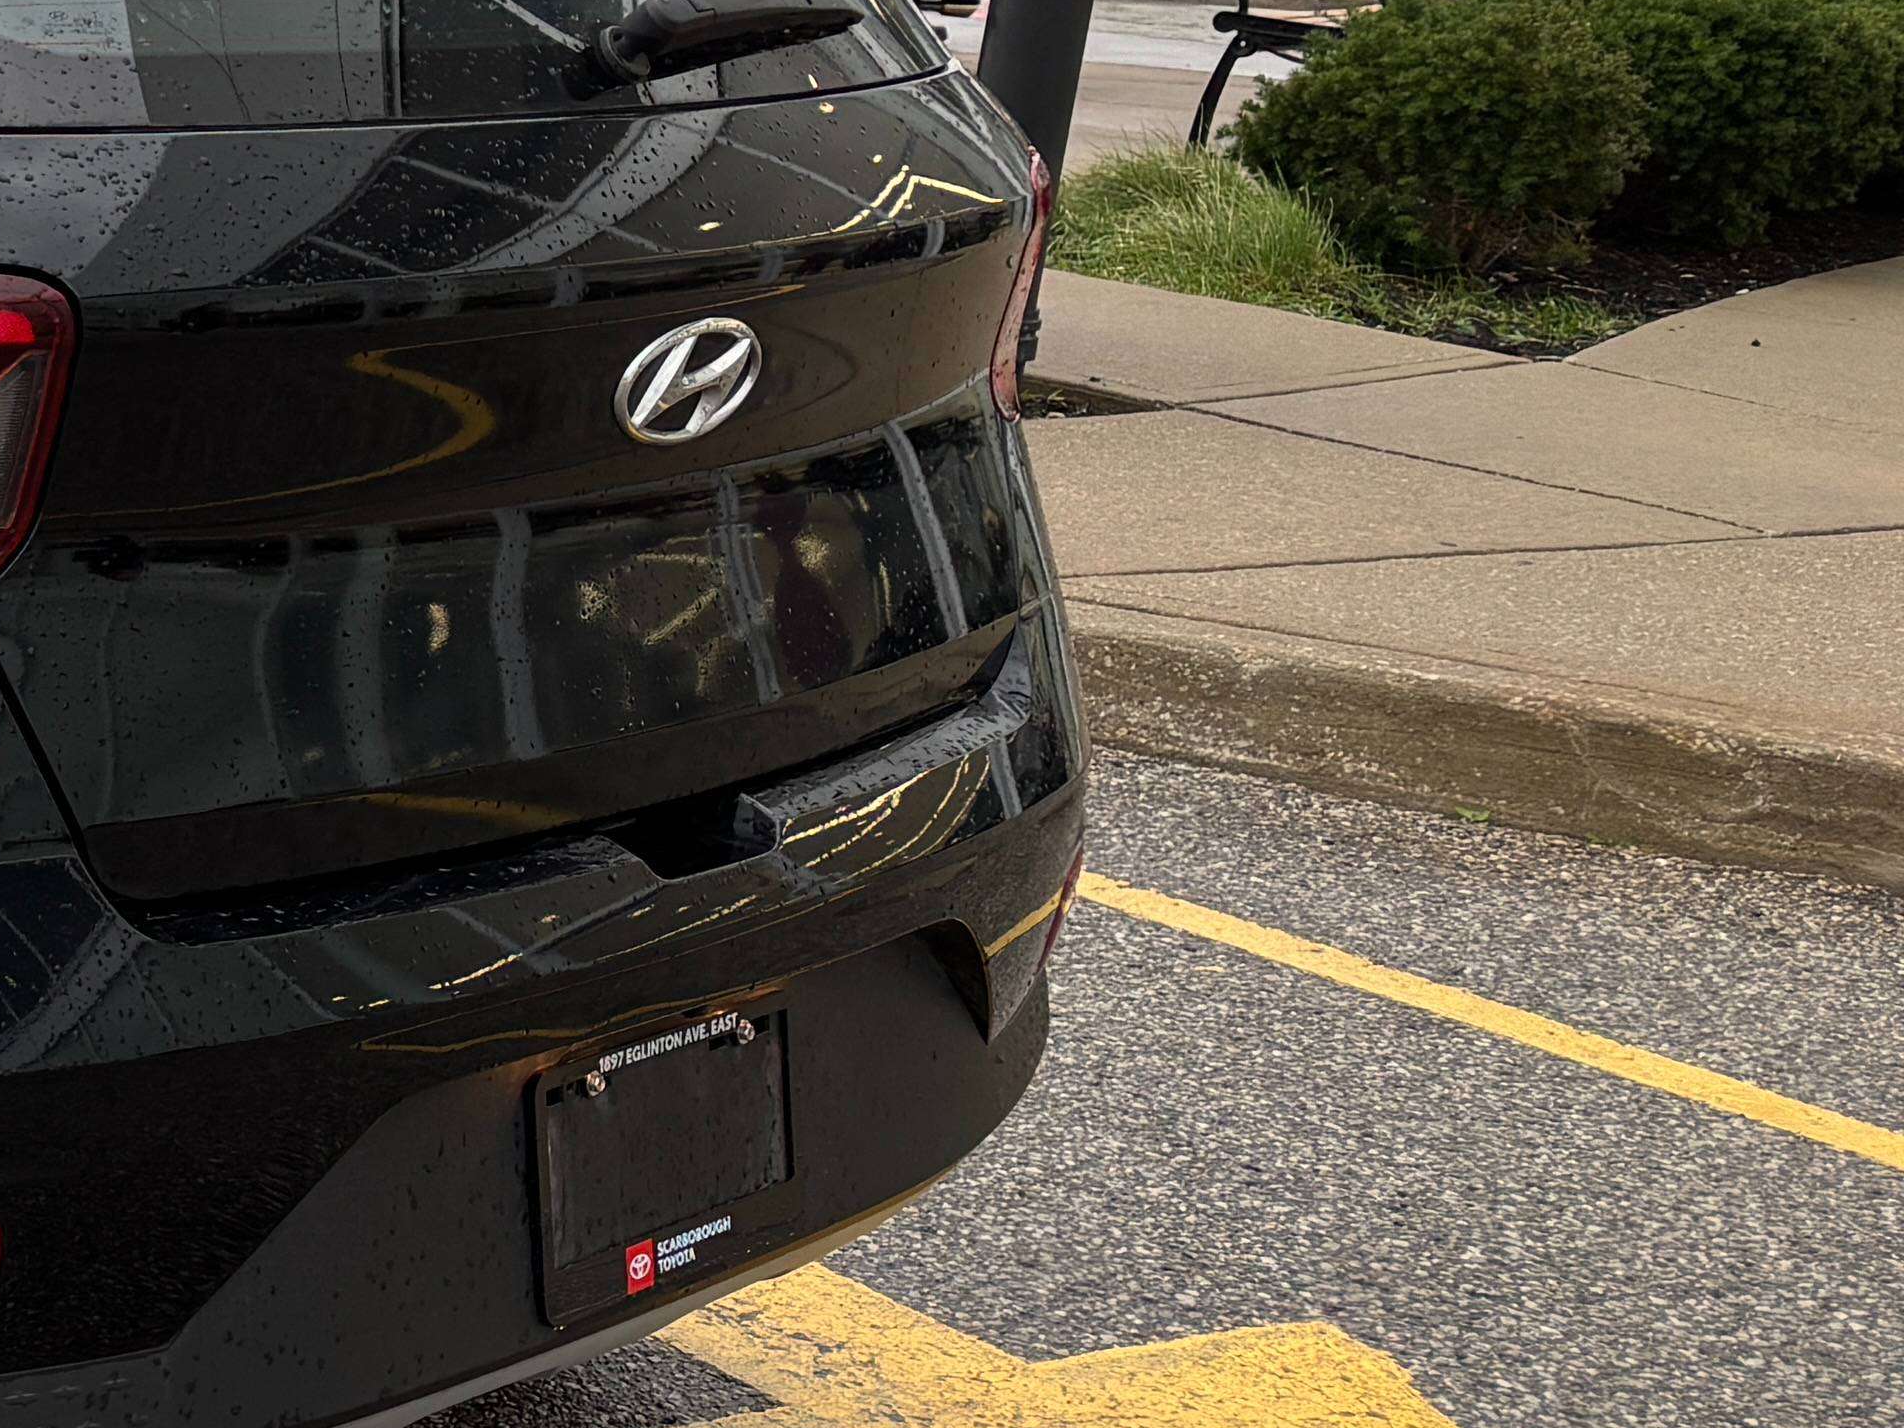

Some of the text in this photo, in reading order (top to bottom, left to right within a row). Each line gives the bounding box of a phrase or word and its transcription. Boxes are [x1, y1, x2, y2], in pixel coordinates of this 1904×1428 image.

[598, 1012, 739, 1073] 1897 EGLINTON AVE. EAST
[657, 1215, 732, 1257] SCARBOROUGH
[657, 1247, 696, 1274] TOYOTA
